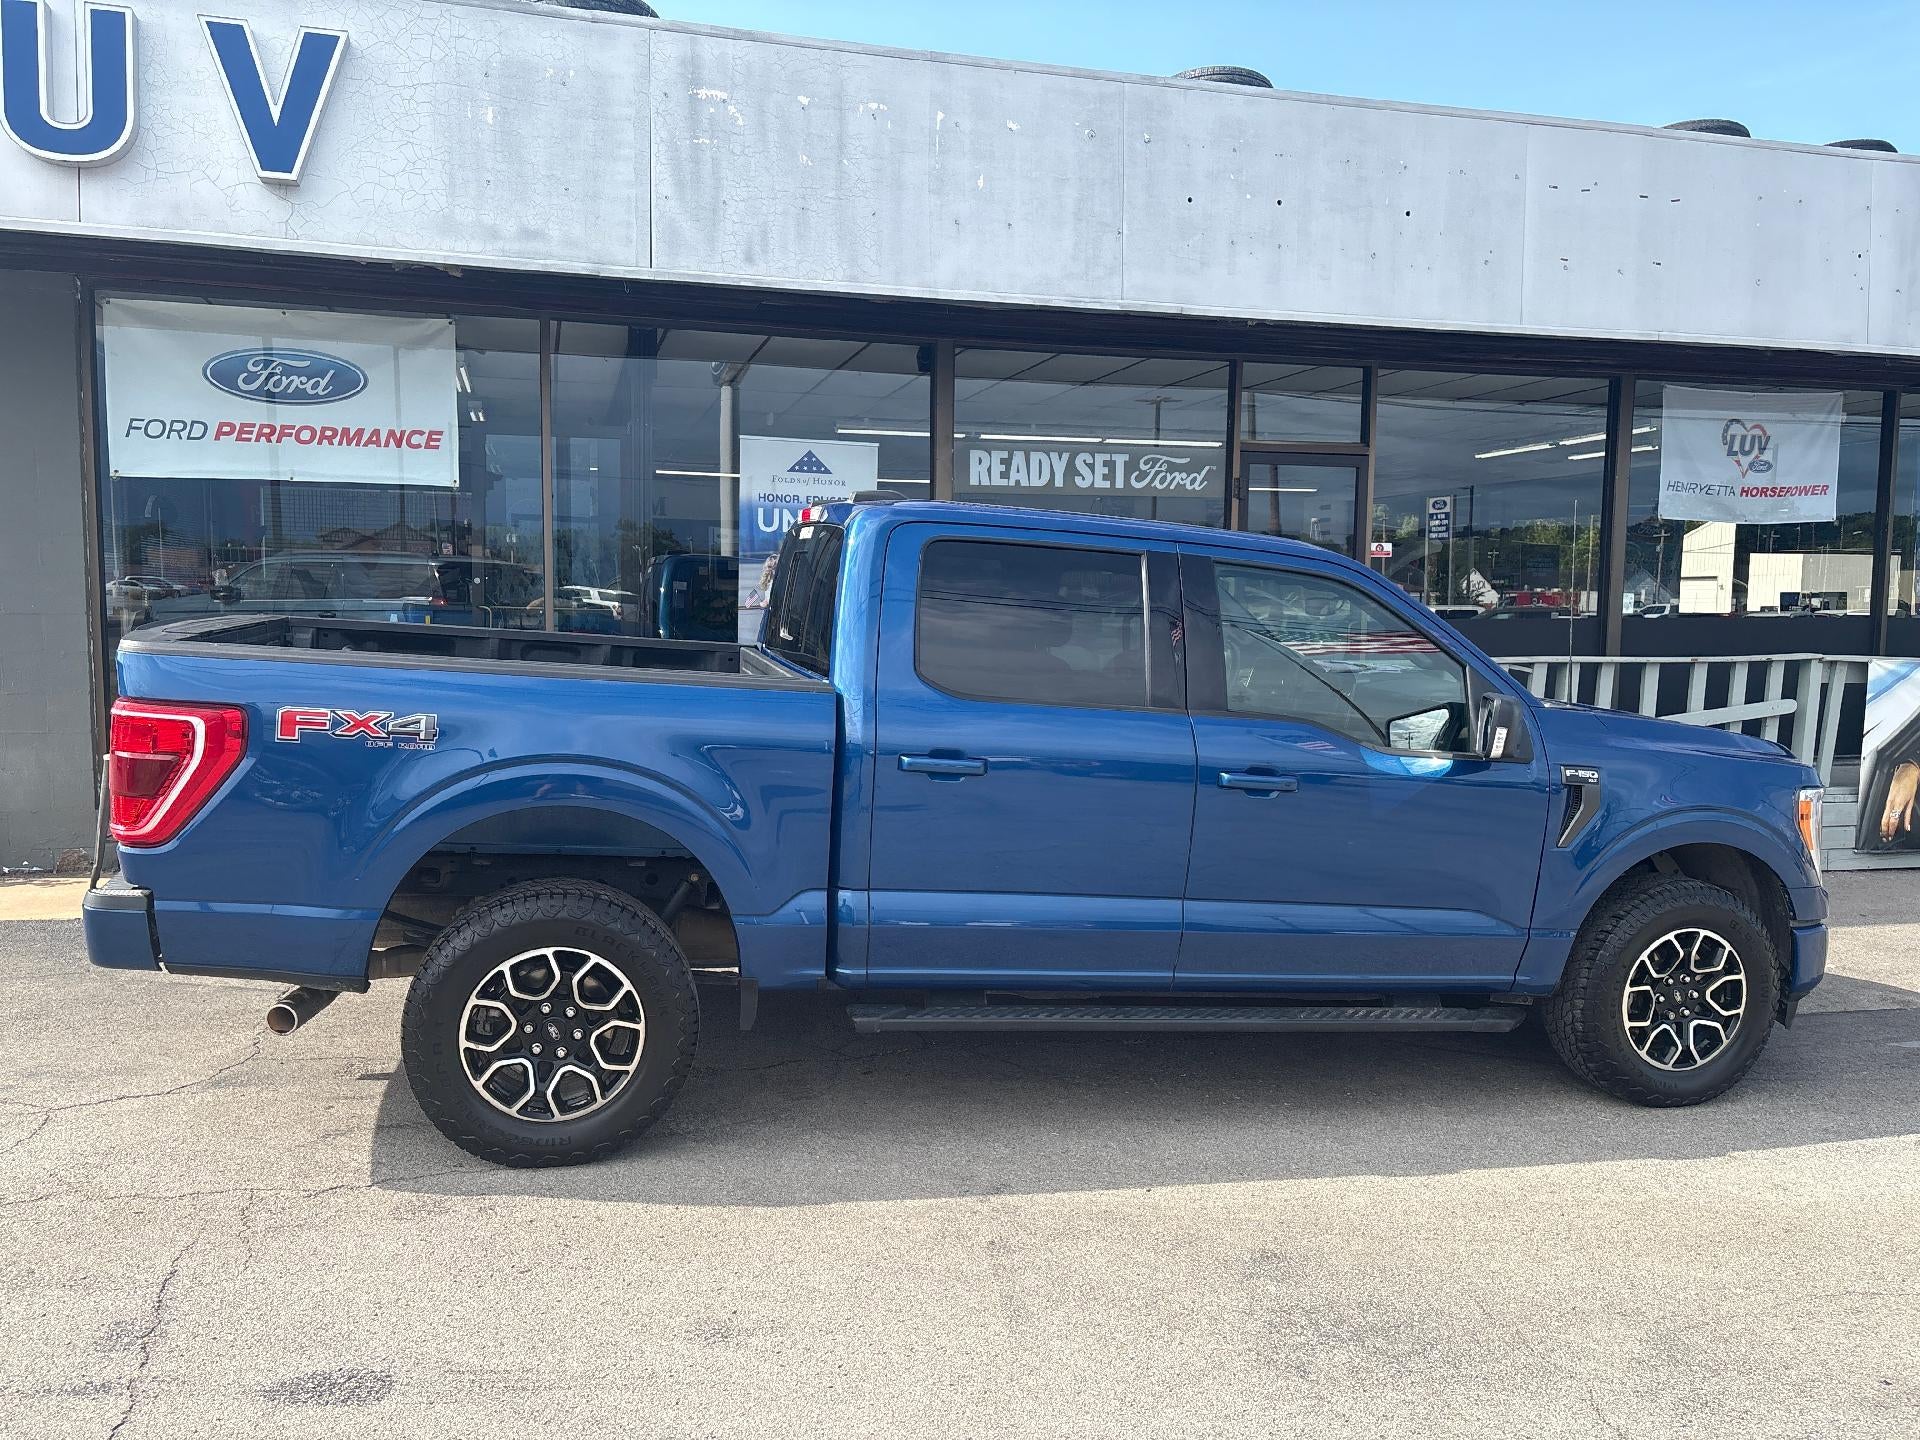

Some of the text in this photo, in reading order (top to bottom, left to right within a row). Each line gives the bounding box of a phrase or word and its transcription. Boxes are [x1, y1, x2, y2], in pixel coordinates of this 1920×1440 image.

[237, 356, 336, 396] Ford
[125, 418, 445, 450] FORD PERFORMANCE
[1727, 434, 1770, 456] LUV
[969, 450, 1072, 488] READY
[1074, 452, 1129, 489] SET
[1130, 454, 1210, 490] Ford
[1666, 480, 1829, 498] HENRYETTA HORSEPOWER
[275, 706, 440, 743] FX4
[1566, 769, 1599, 778] F-150
